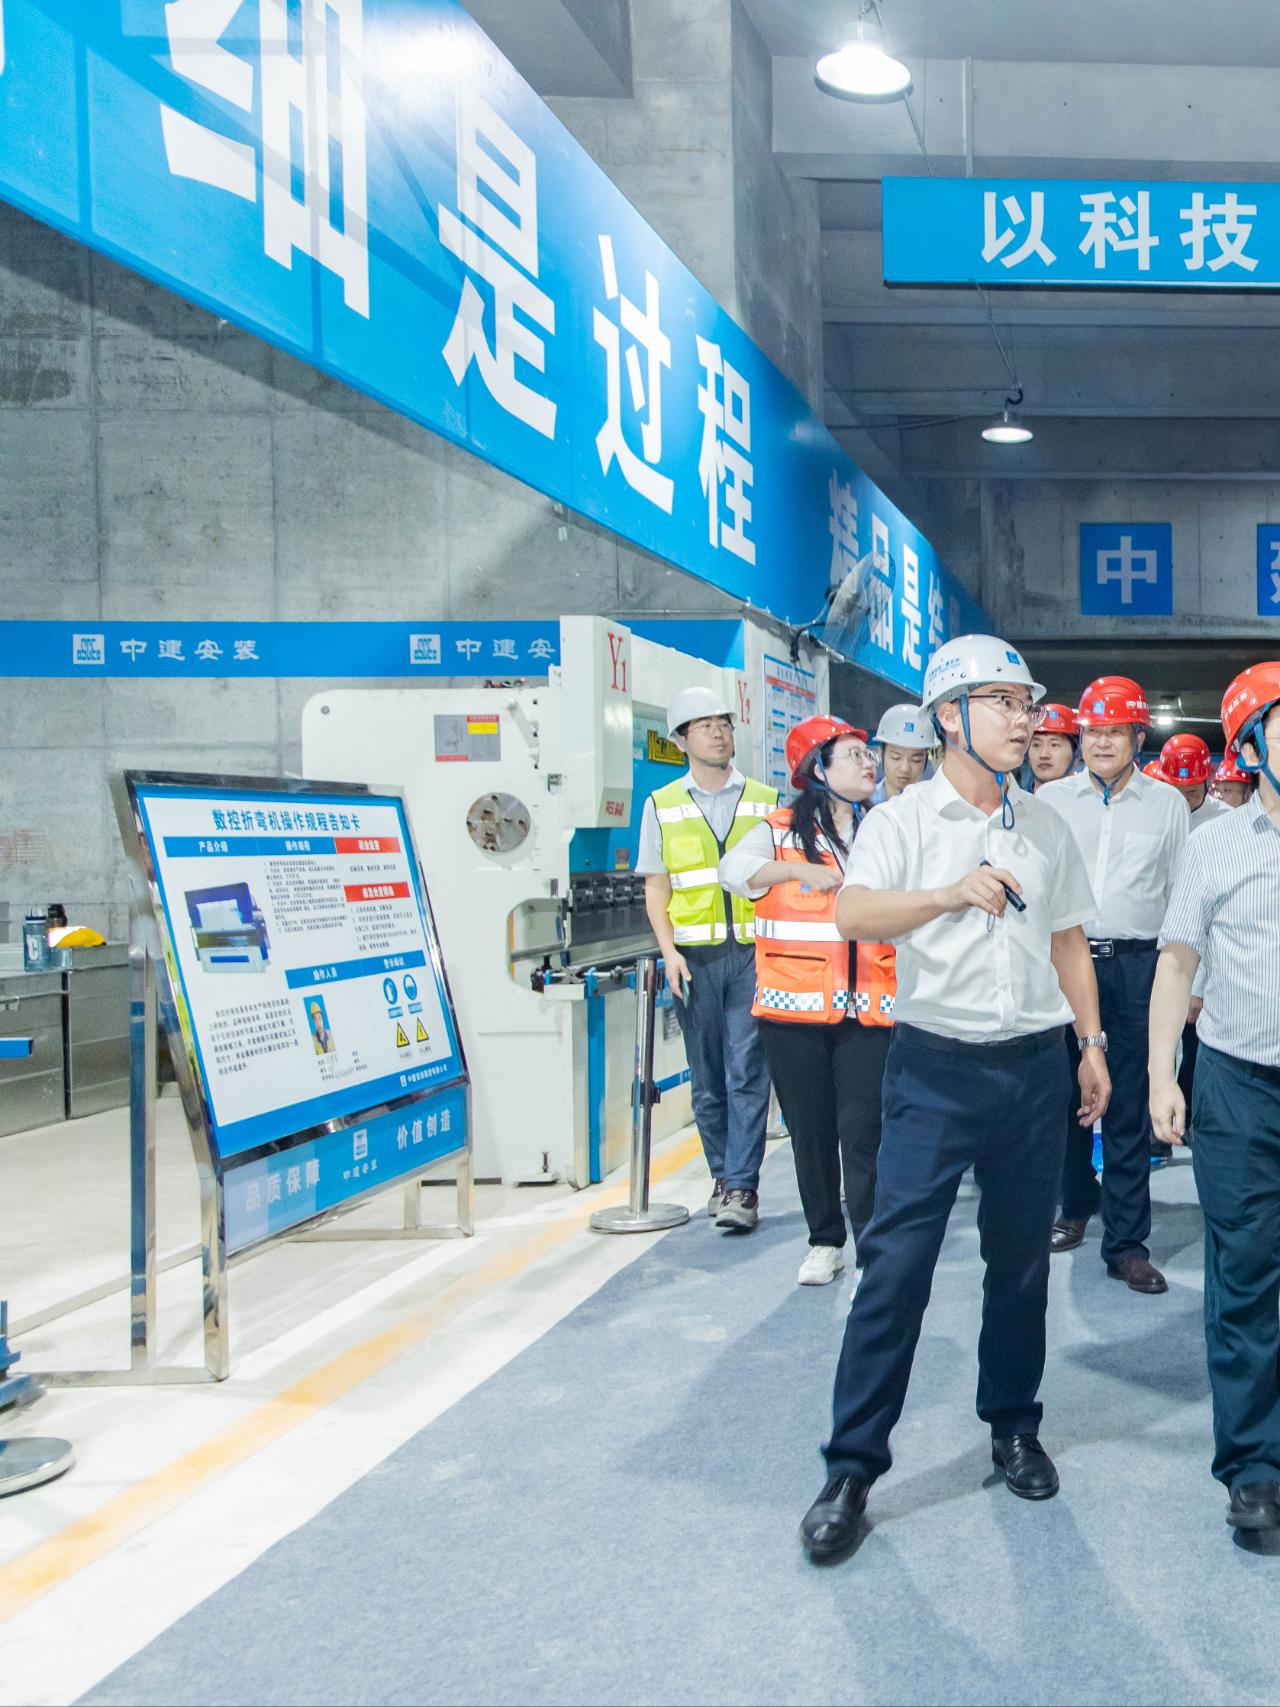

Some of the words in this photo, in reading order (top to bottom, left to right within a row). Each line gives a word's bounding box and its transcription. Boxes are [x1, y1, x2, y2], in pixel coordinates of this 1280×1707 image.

[1097, 536, 1159, 604] 中
[120, 638, 260, 662] 中建安装
[212, 808, 361, 832] 数控折弯机操作规程告知卡
[396, 1109, 451, 1151] 价值创造
